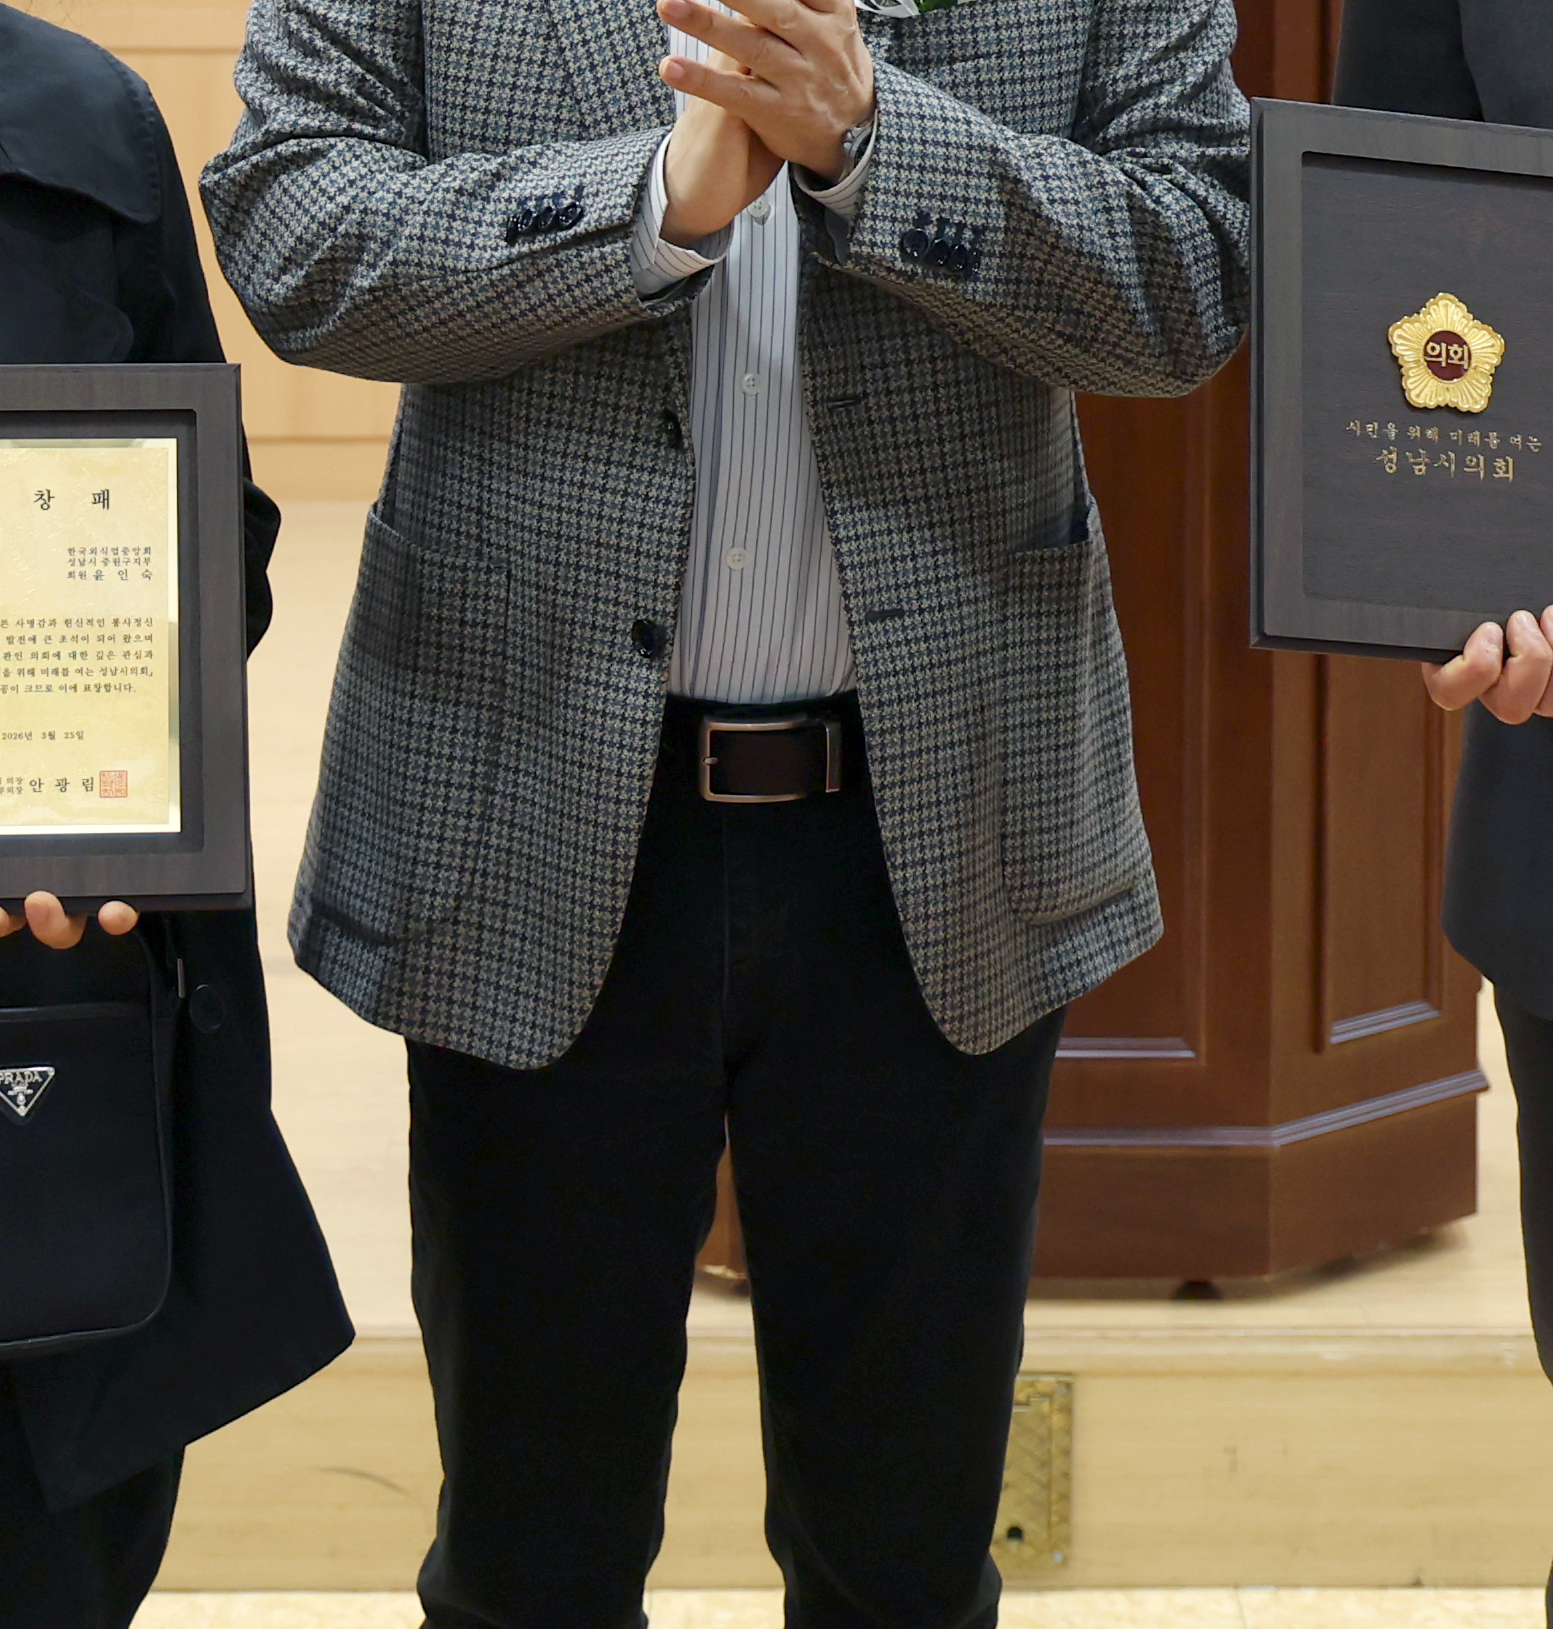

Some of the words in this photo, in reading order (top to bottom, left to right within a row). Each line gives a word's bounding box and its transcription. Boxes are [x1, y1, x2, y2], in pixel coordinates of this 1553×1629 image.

[1426, 341, 1469, 370] 의회
[1376, 445, 1515, 483] 성남시의회
[2, 731, 33, 741] 2026년
[64, 731, 84, 740] 25일
